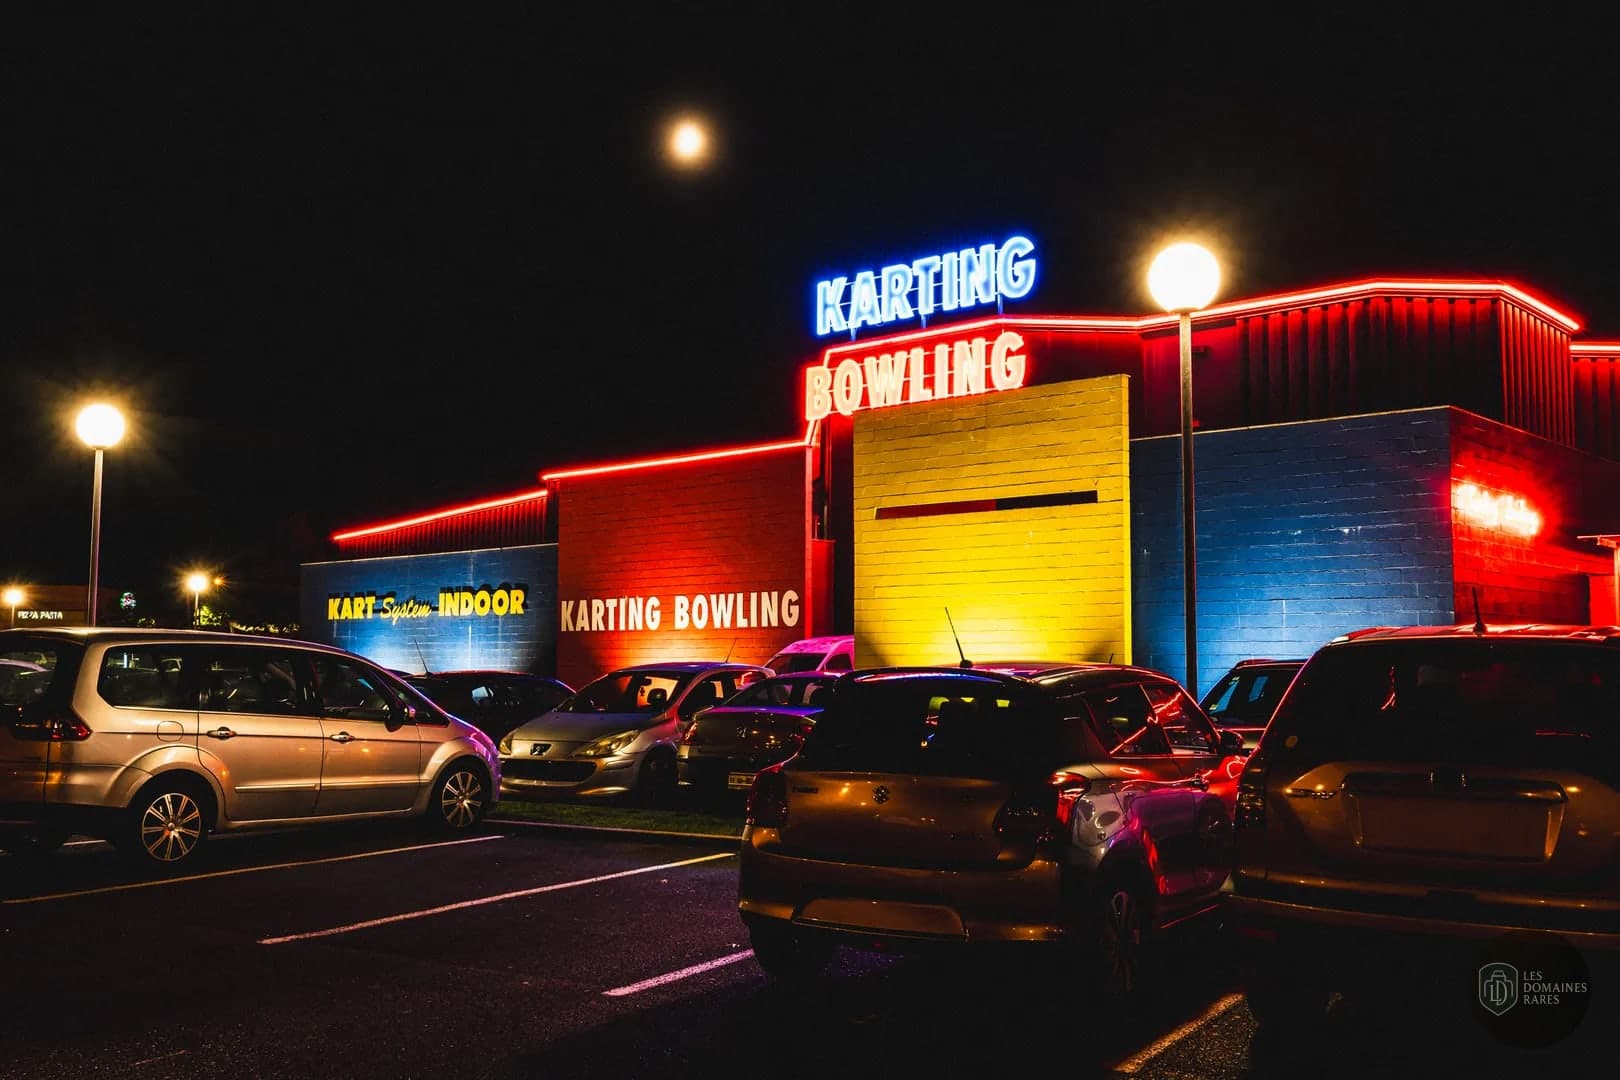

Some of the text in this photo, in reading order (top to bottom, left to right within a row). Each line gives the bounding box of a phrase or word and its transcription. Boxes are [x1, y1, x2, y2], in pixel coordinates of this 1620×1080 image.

[815, 235, 1037, 336] KARTING
[804, 330, 1027, 422] BOWLING
[40, 610, 64, 620] PASTA
[327, 588, 525, 626] KART System INDOOR
[560, 589, 800, 632] KARTING BOWLING
